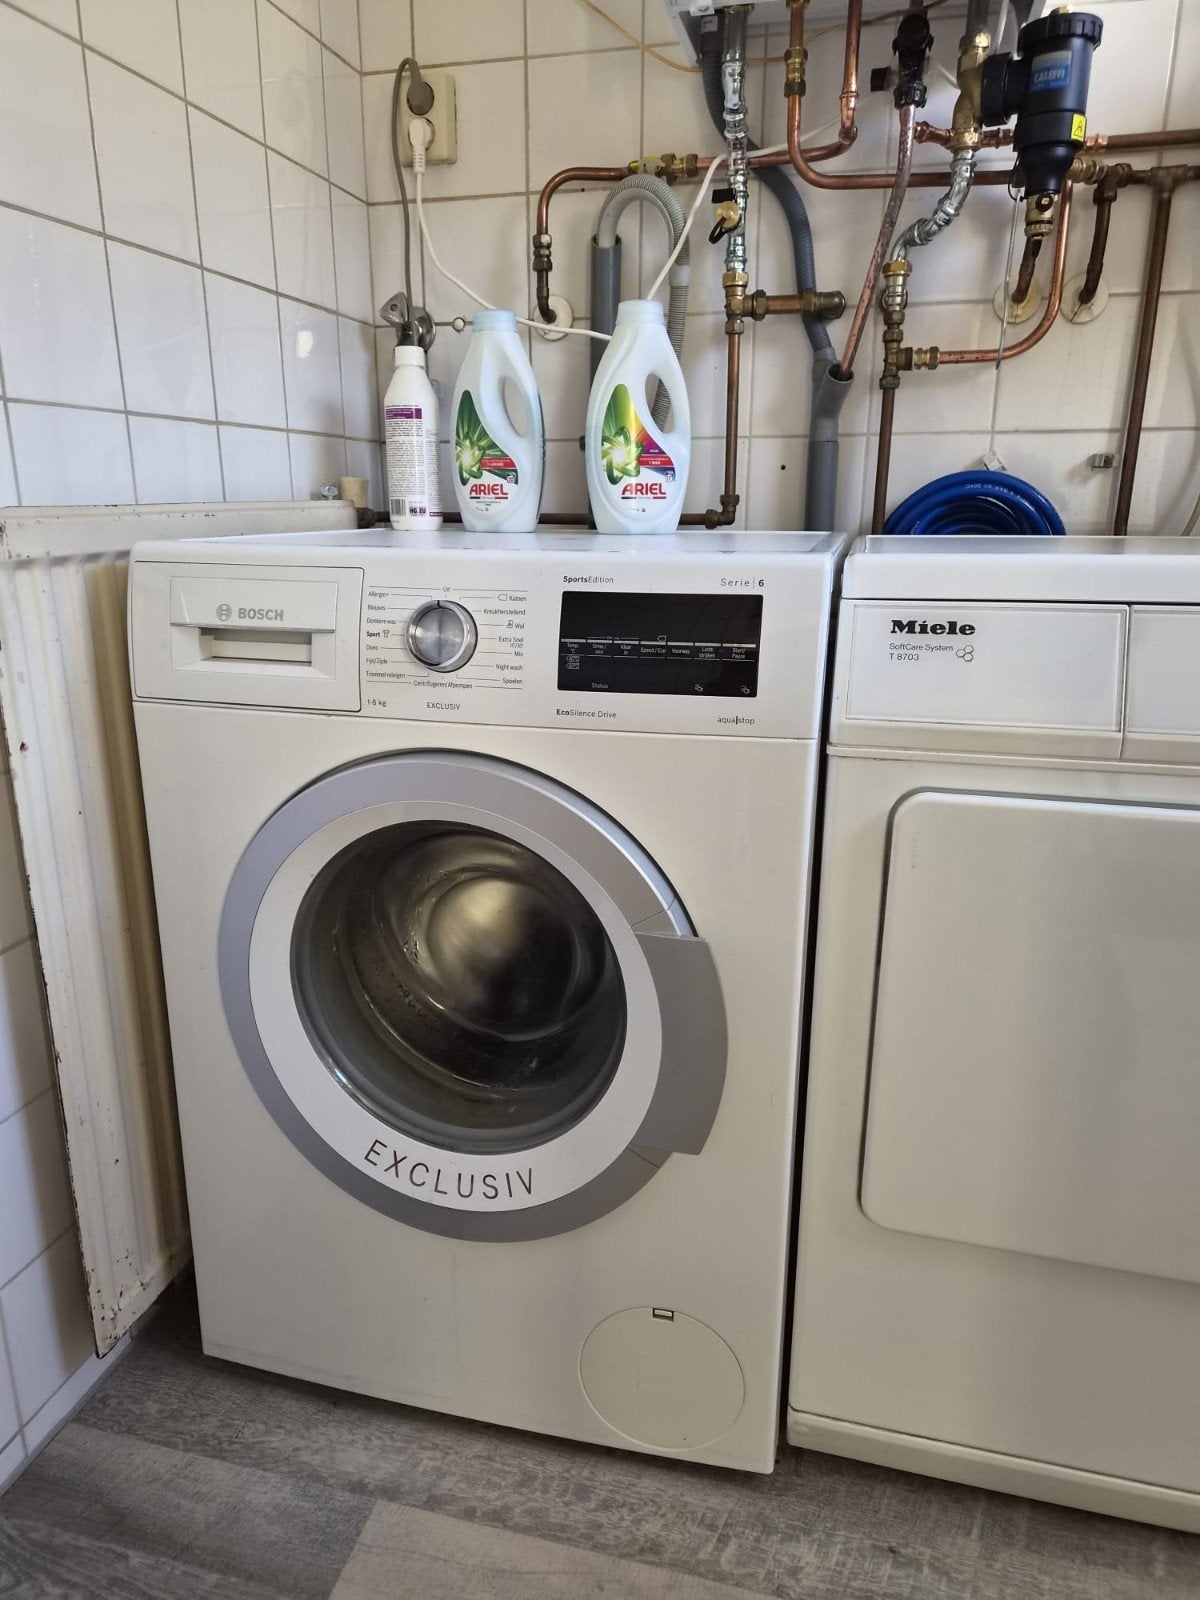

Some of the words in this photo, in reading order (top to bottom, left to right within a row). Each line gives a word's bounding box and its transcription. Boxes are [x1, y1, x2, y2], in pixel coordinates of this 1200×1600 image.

[1034, 69, 1065, 83] CALEFFI
[469, 483, 508, 495] ARIEL
[621, 483, 667, 495] ARIEL
[562, 575, 614, 583] SportsEdition
[720, 578, 750, 587] Serie
[758, 579, 765, 587] 6
[238, 607, 284, 621] BOSCH
[890, 619, 976, 635] Miele
[366, 630, 380, 638] Sport
[889, 643, 924, 651] SoftCare
[925, 644, 954, 652] System
[426, 701, 461, 710] EXCLUSIV
[556, 708, 596, 718] EcoSilence
[597, 710, 617, 719] Drive
[364, 1139, 532, 1200] EXCLUSIV
